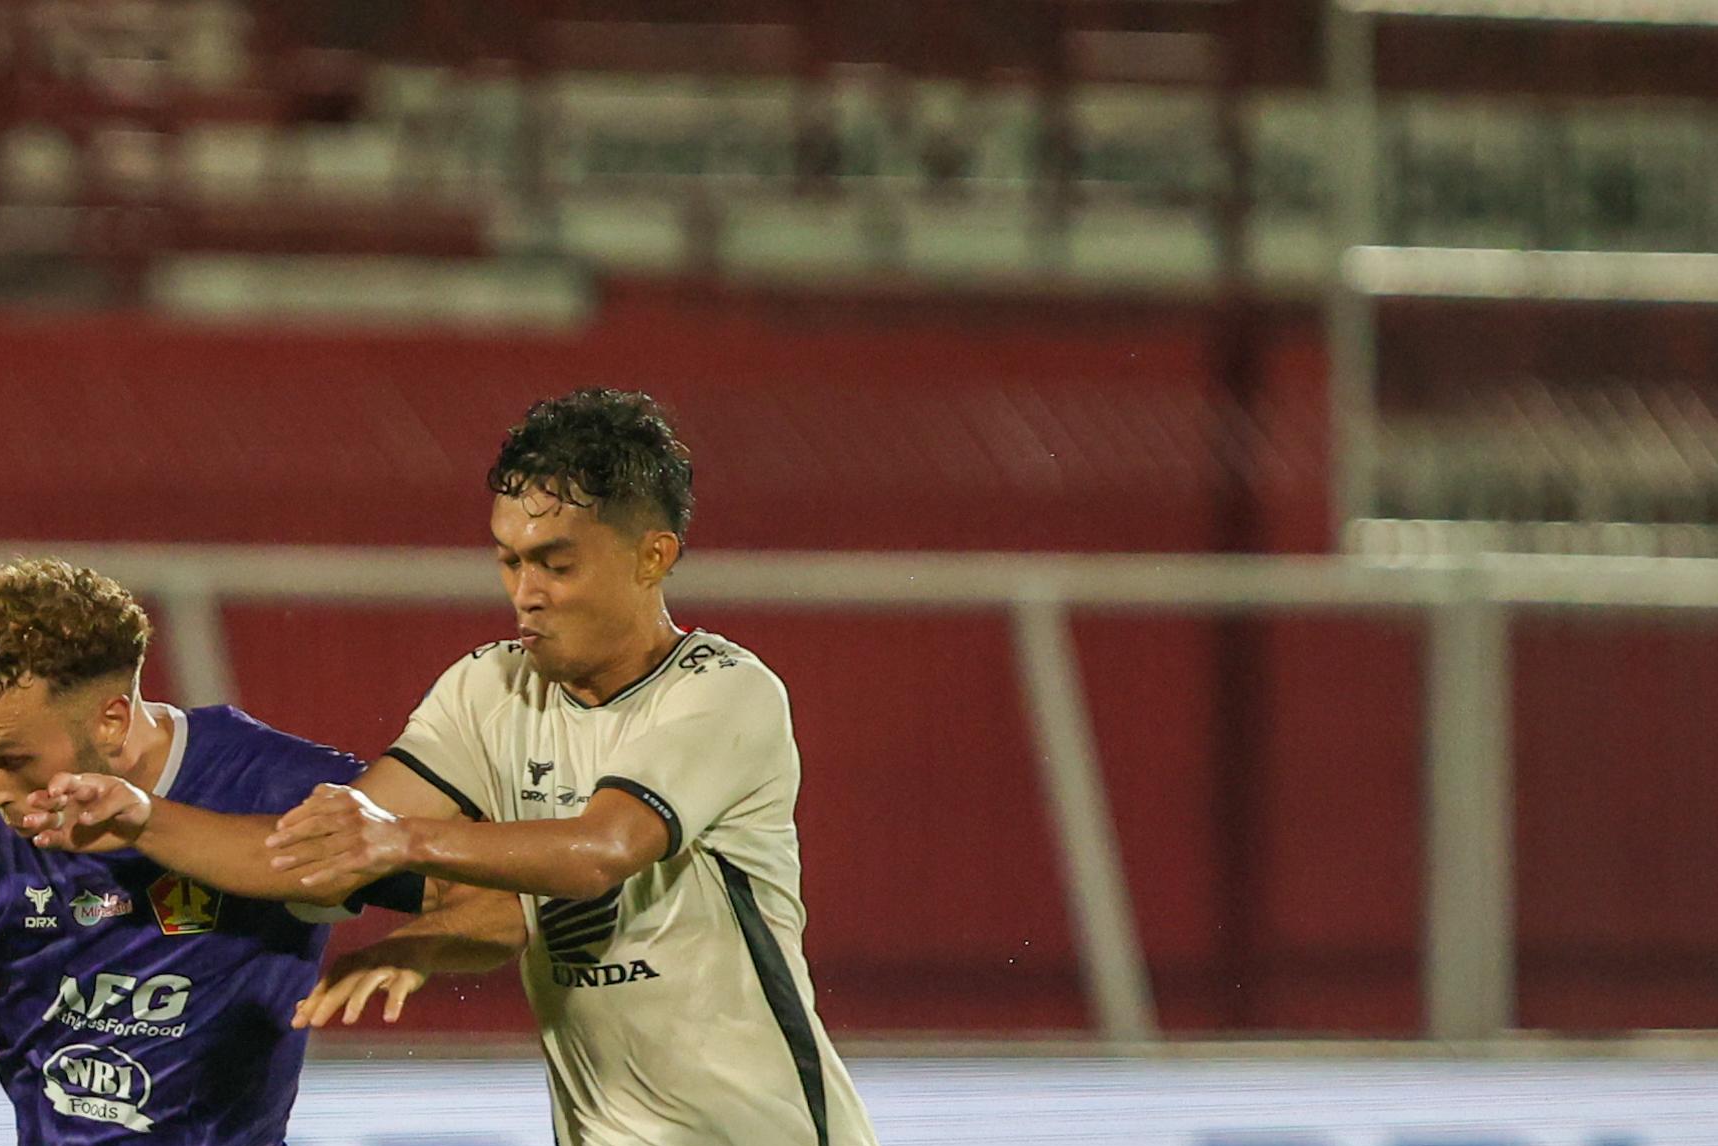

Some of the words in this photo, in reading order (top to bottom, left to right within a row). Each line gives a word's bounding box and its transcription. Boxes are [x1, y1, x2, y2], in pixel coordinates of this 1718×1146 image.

[25, 916, 58, 928] DRX
[553, 959, 660, 988] ONDA
[42, 973, 193, 1021] AFG
[60, 1055, 132, 1100] WBI
[69, 1098, 118, 1120] Foods
